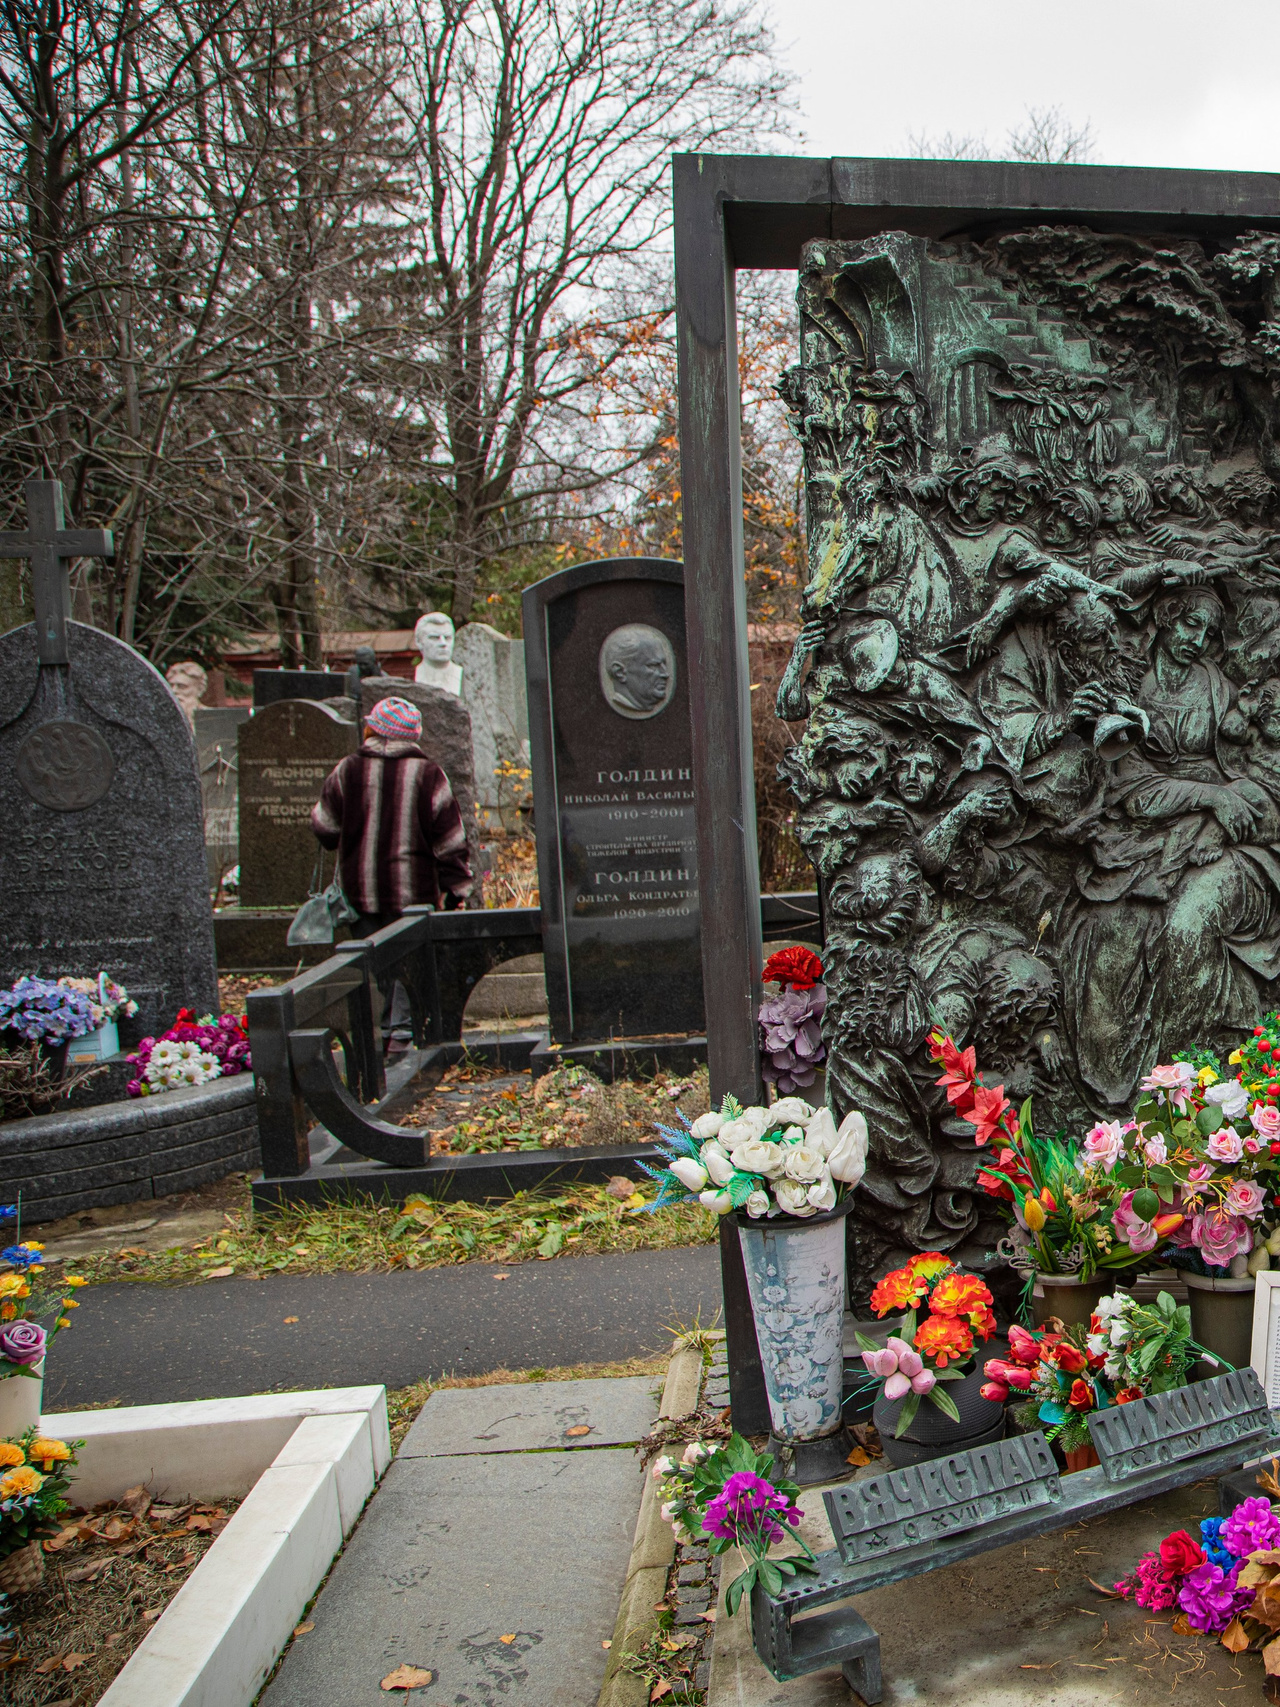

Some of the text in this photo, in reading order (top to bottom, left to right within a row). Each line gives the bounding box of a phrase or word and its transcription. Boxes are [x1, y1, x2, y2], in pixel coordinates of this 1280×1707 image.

[261, 767, 325, 779] ЛЕОНОВ
[597, 768, 691, 784] ГОЛДИН
[564, 790, 629, 804] НИКОЛАЙ
[576, 893, 620, 903] ОЛЬГА
[1094, 1368, 1268, 1456] ТИХОНОВ
